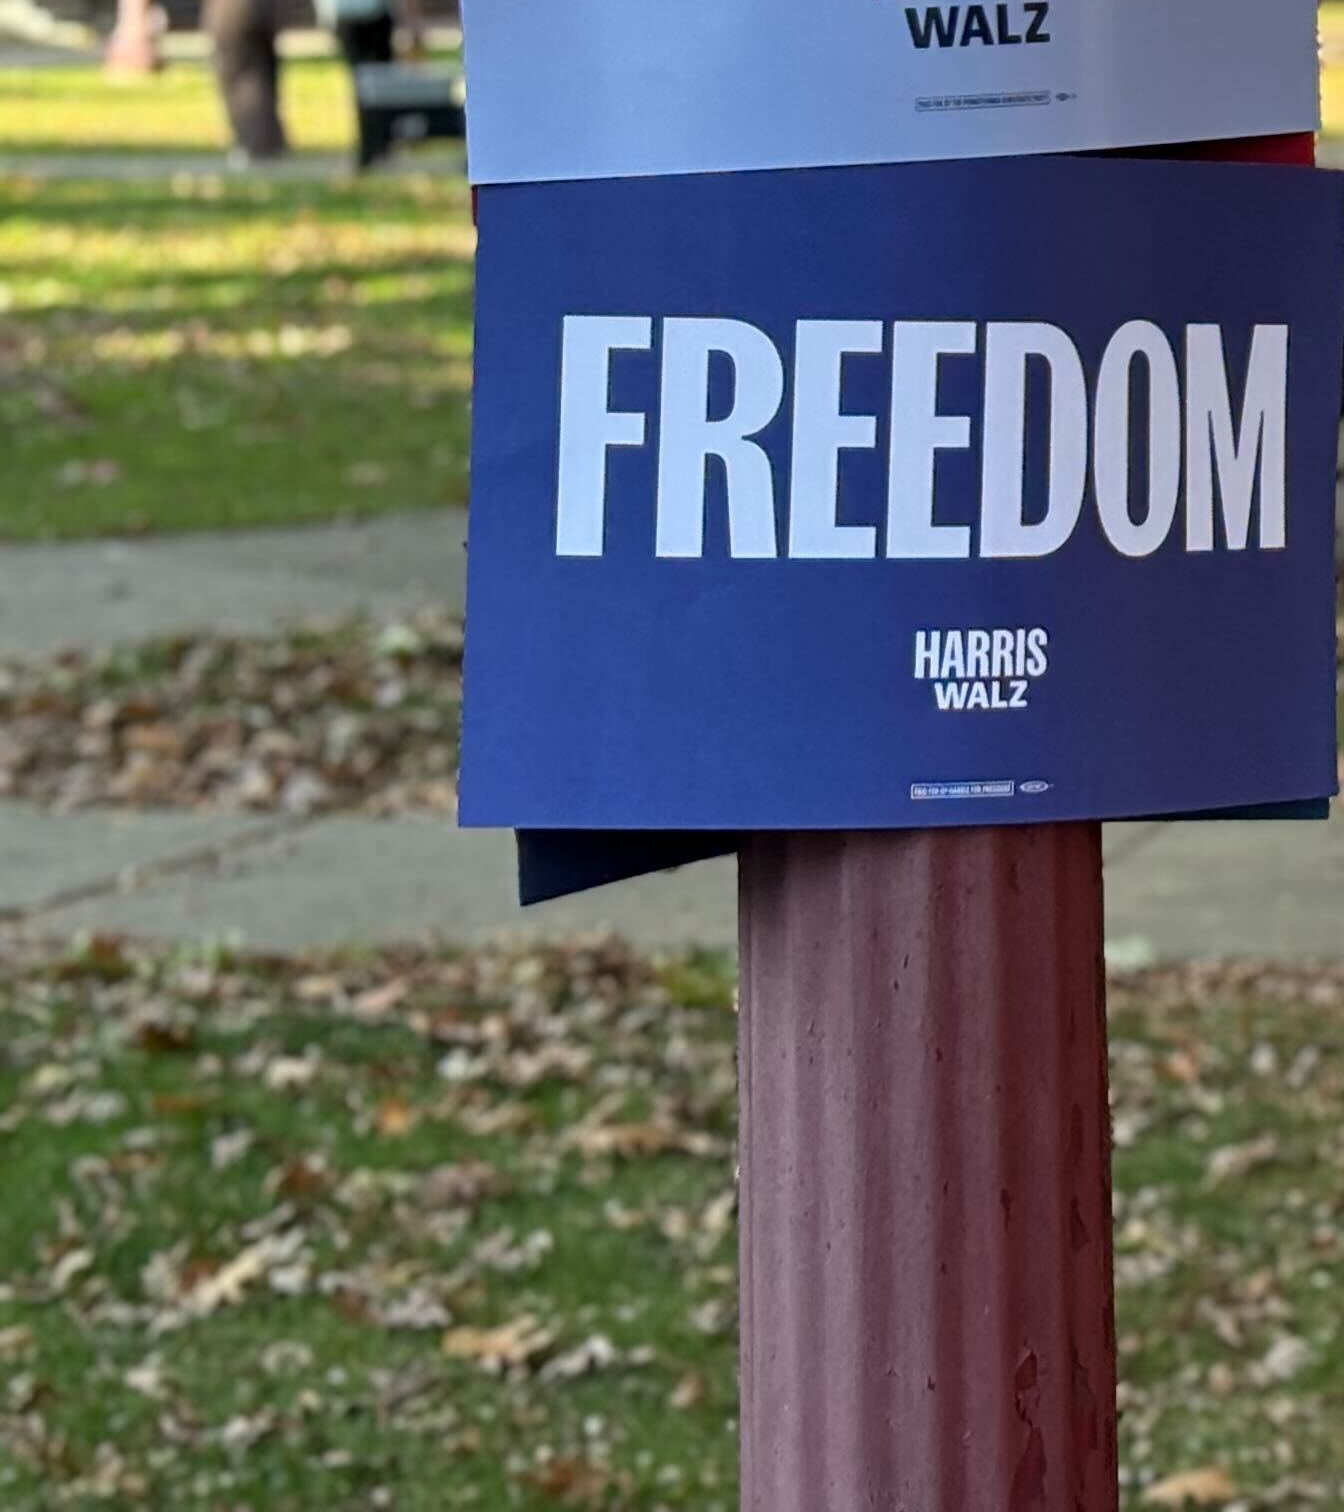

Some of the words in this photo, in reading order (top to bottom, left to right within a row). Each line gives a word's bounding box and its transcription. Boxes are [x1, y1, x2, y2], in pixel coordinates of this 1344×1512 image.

[904, 1, 1051, 49] WALZ
[555, 314, 1288, 559] FREEDOM
[914, 628, 1048, 680] HARRIS
[933, 680, 1028, 710] WALZ
